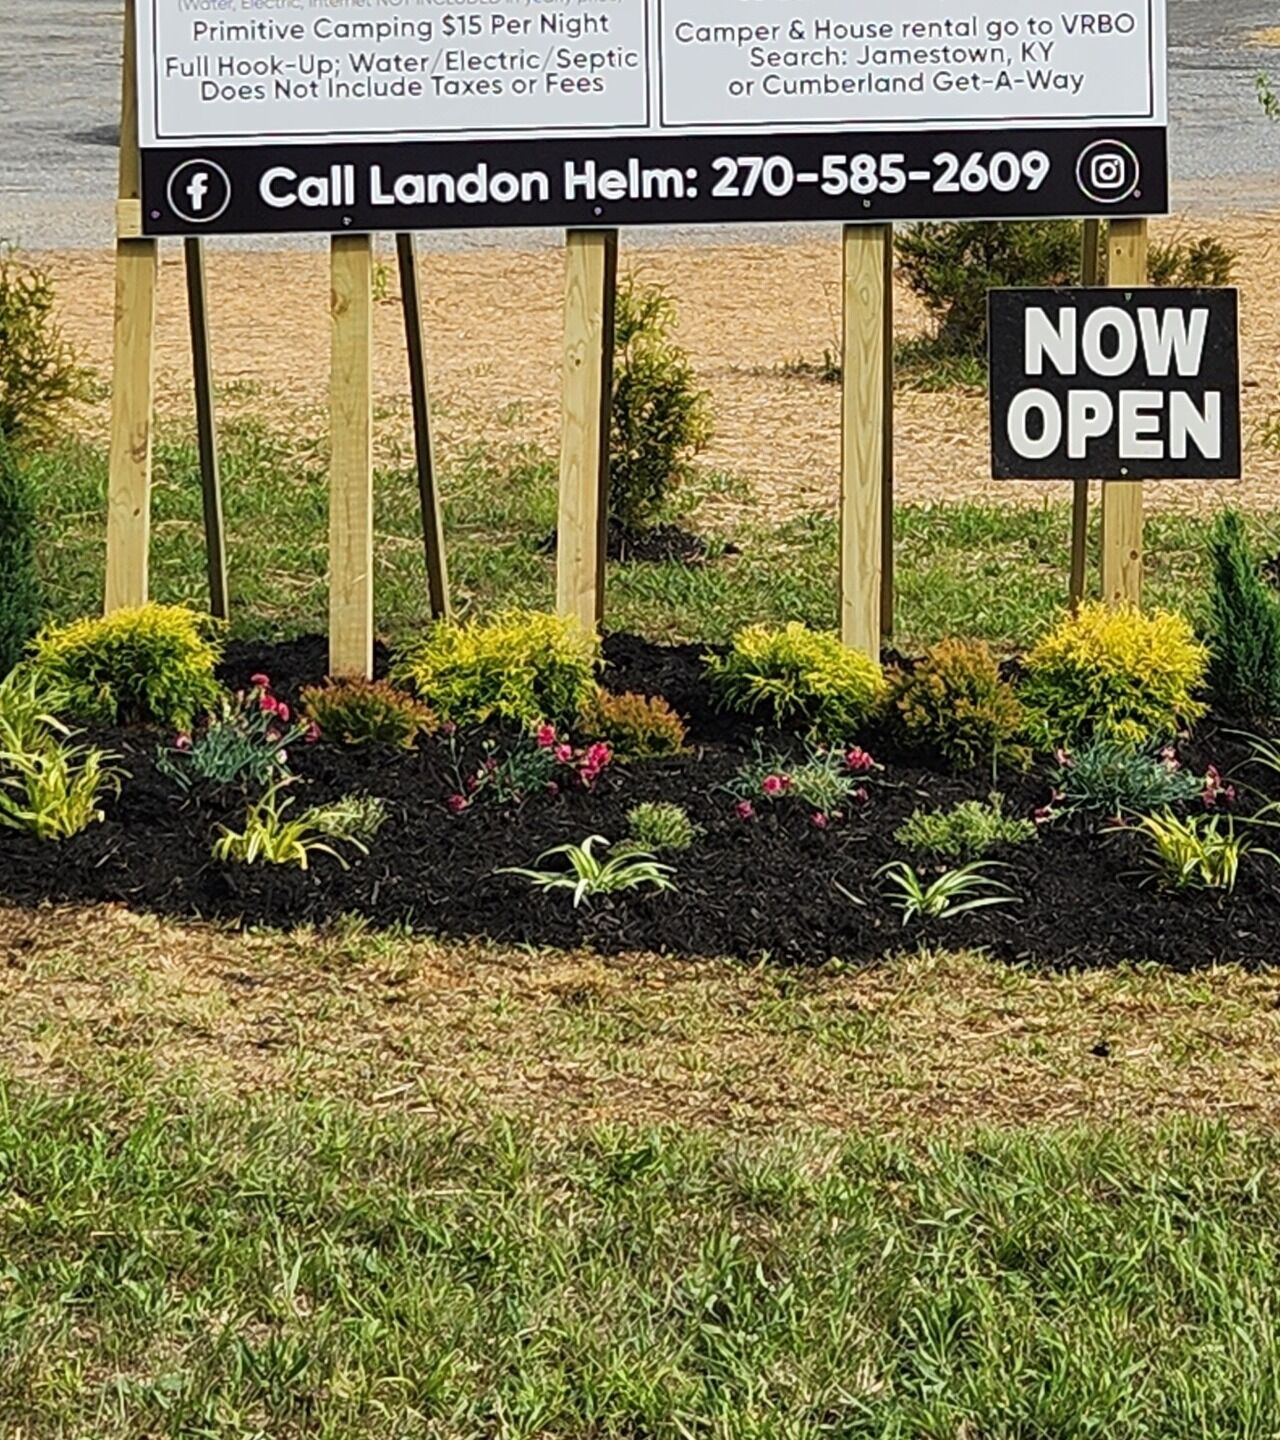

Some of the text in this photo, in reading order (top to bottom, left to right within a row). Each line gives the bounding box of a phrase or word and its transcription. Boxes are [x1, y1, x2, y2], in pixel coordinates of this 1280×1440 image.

[194, 13, 608, 42] Primitive Camping $15 Per Night
[676, 13, 1134, 47] Camper & House rental go to VRBO
[166, 56, 208, 77] Full
[219, 55, 339, 79] Hook-Up;
[751, 42, 1054, 67] Search: Jamestown, KY
[202, 73, 603, 101] Does Not Include Taxes or Fees
[729, 81, 754, 95] or
[763, 72, 923, 94] Cumberland
[260, 150, 1050, 207] Call Landon Helm: 270-585-2609
[1025, 306, 1209, 376] NOW
[1007, 388, 1220, 459] OPEN
